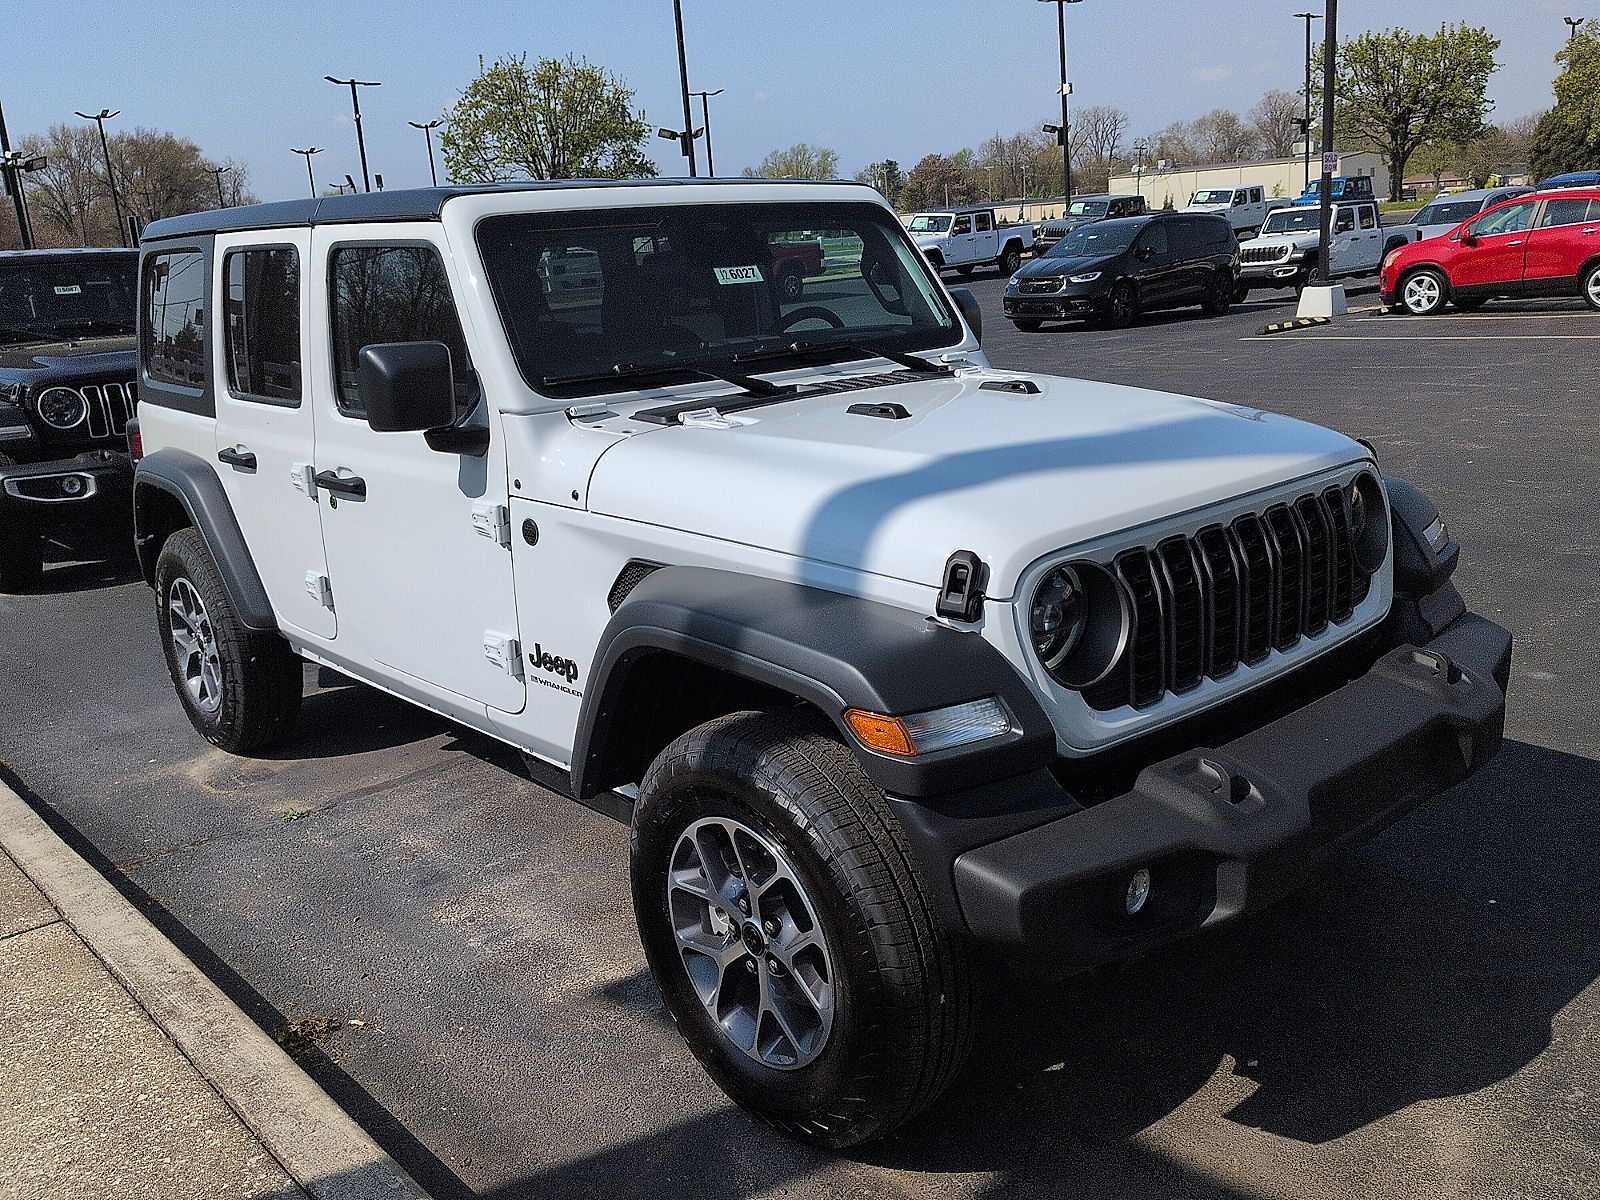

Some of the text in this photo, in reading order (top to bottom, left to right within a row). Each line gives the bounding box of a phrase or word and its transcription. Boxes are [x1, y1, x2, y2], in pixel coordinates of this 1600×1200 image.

[1324, 153, 1338, 163] SOLD
[528, 642, 578, 684] Jeep
[538, 677, 583, 698] WRANGLER
